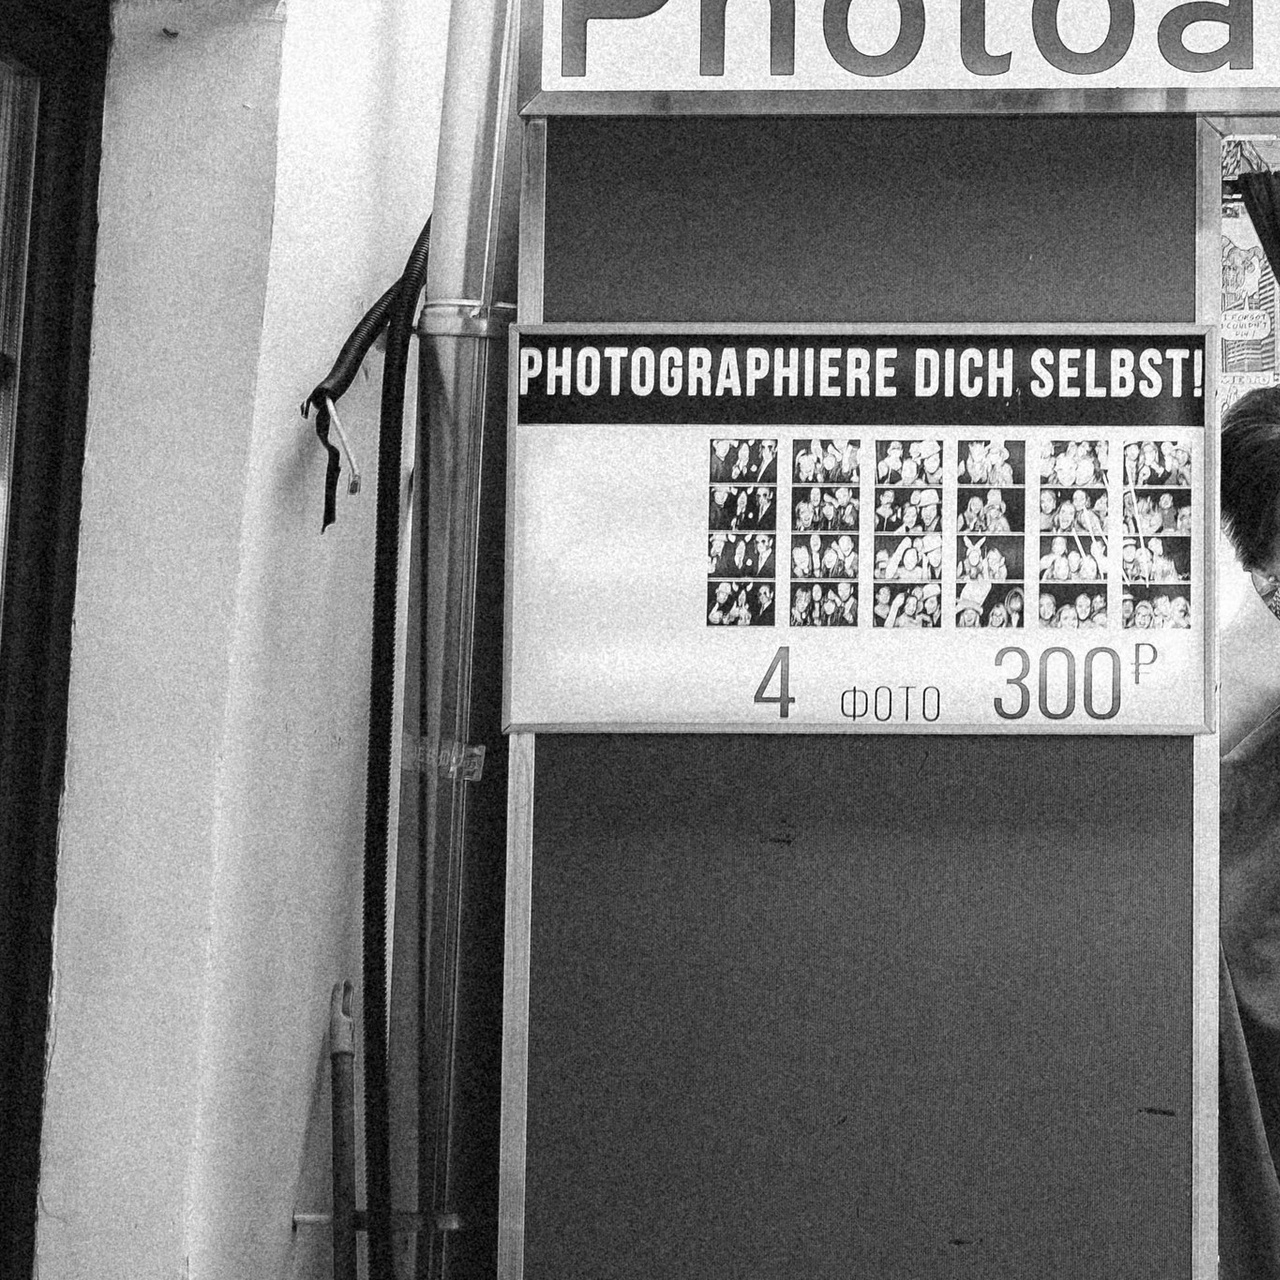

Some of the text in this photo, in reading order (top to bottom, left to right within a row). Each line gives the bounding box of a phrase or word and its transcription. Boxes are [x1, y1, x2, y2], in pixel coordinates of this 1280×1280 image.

[518, 346, 1203, 399] PHOTOGRAPHIERE DICH SELBST!
[753, 645, 796, 719] 4
